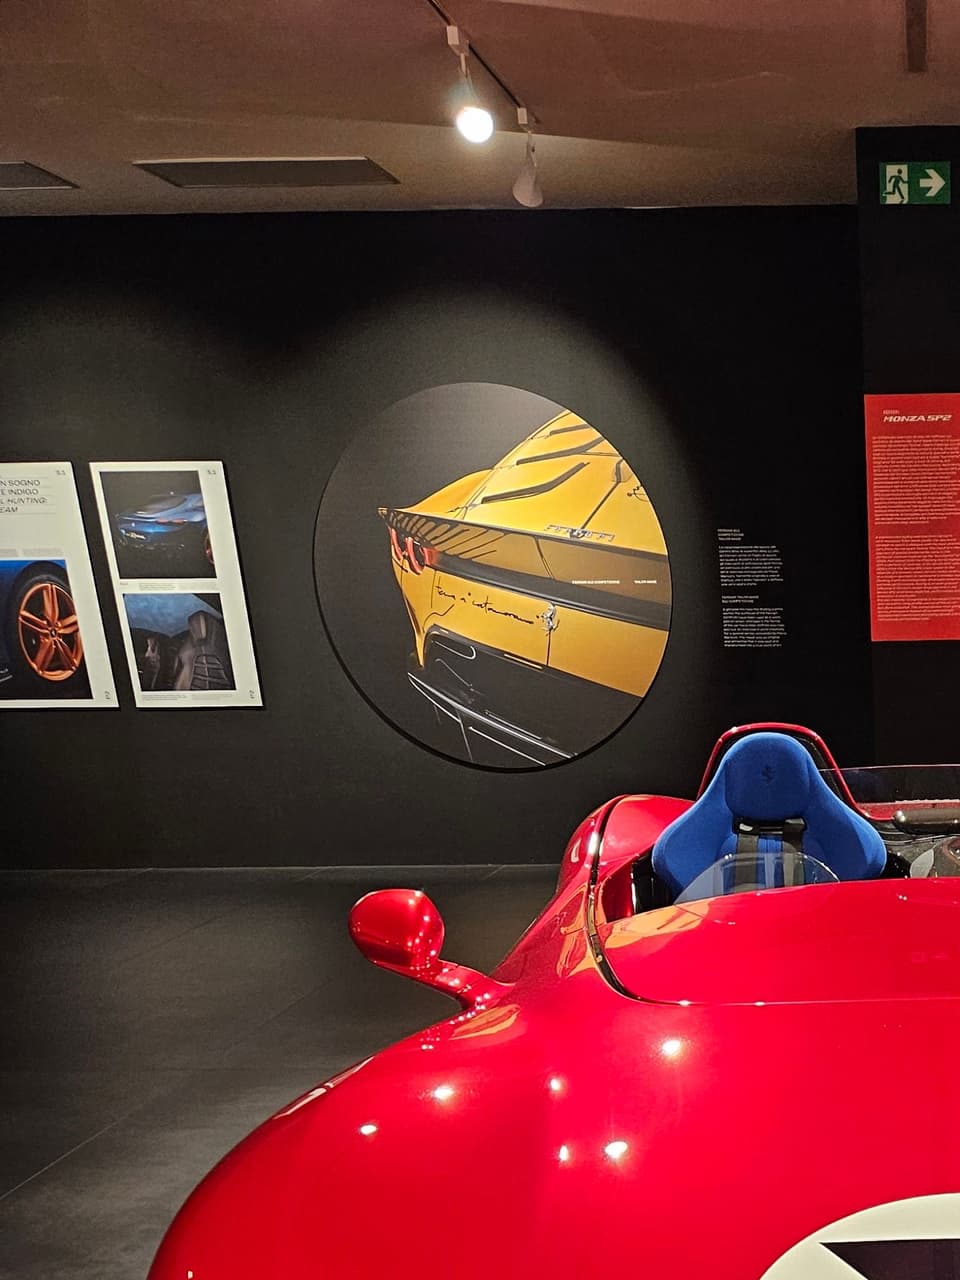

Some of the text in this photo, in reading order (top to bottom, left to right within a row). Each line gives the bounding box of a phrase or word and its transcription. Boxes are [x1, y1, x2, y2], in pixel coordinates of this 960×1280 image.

[883, 414, 952, 423] MONZA SP2
[8, 479, 40, 487] SOGNO
[8, 488, 39, 496] INDIGO
